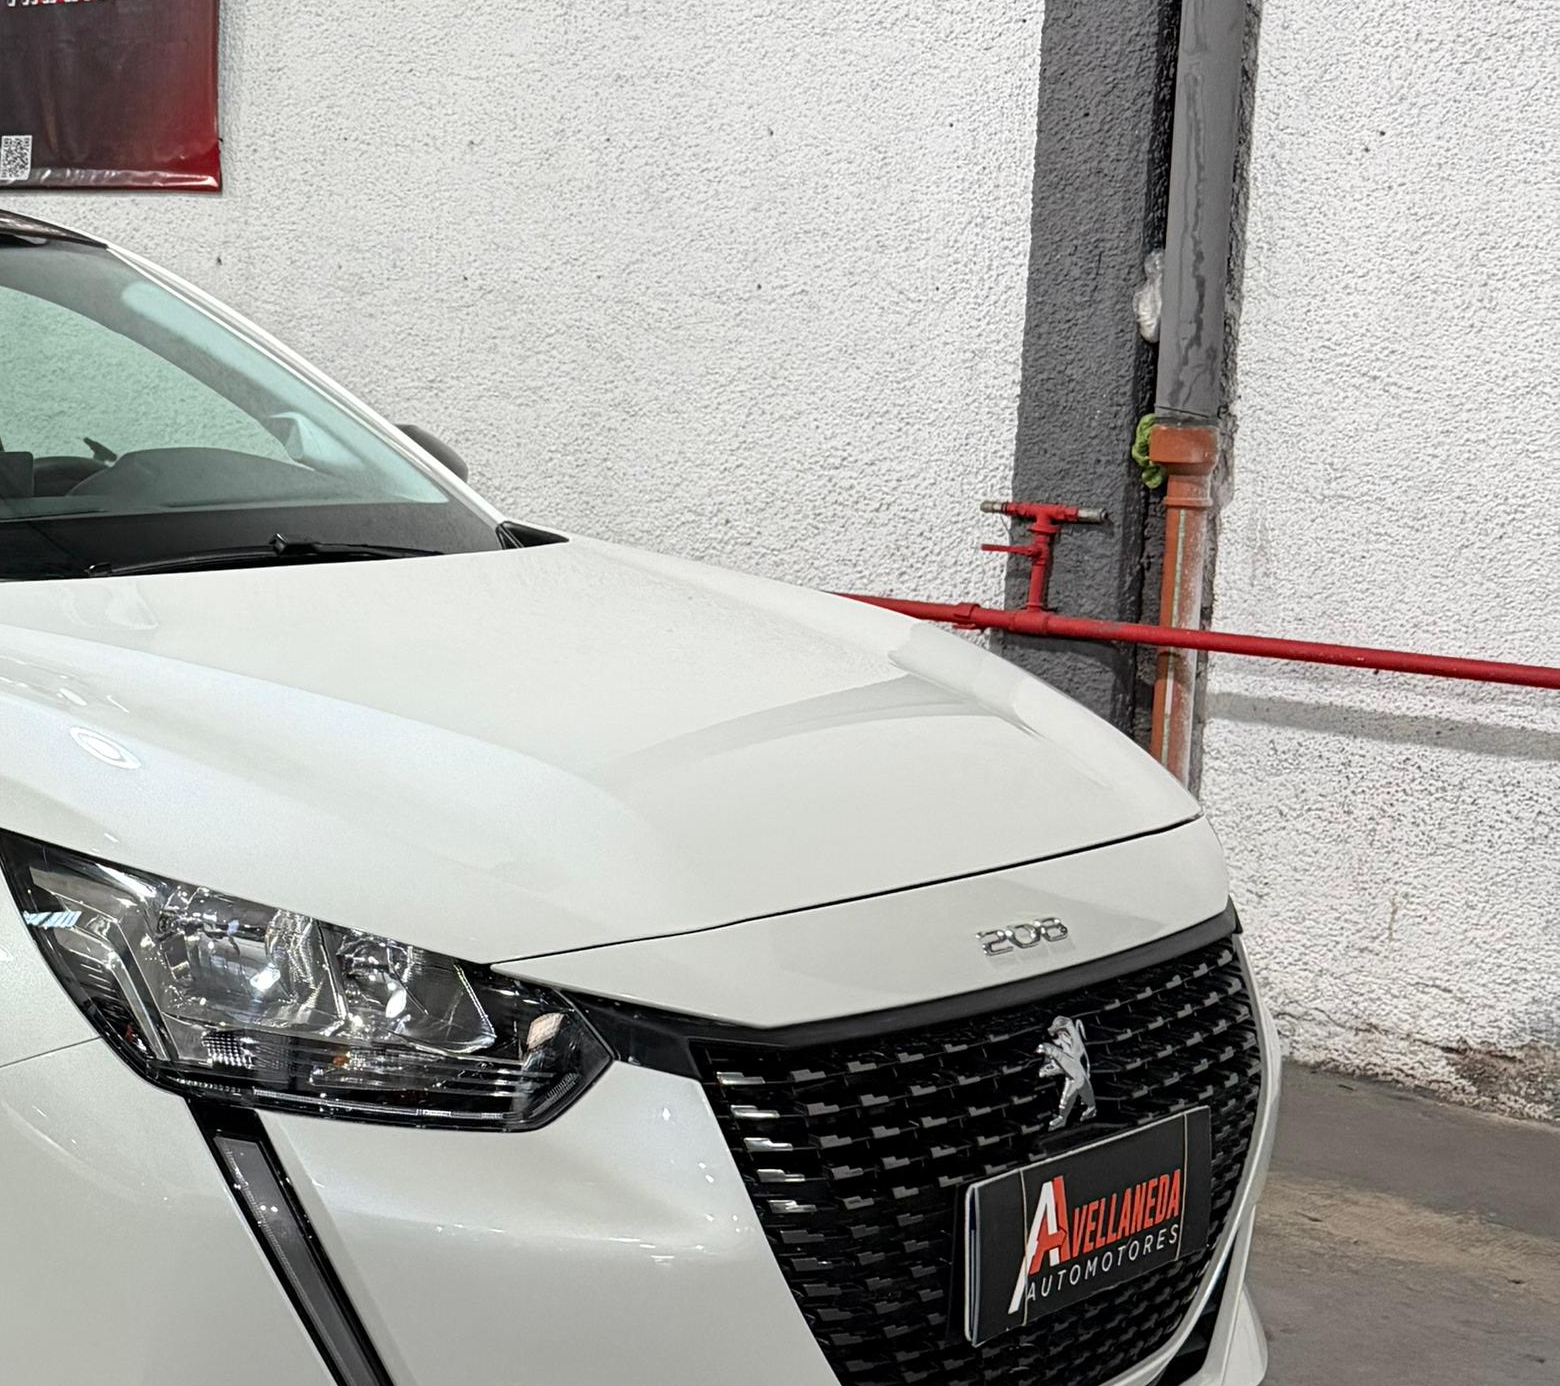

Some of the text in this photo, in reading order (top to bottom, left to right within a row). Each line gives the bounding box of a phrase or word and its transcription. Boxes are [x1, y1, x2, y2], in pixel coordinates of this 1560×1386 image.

[975, 917, 1068, 956] 208
[1007, 1169, 1181, 1314] AVELLANEDA
[1026, 1224, 1179, 1301] AUTOMOTORES
